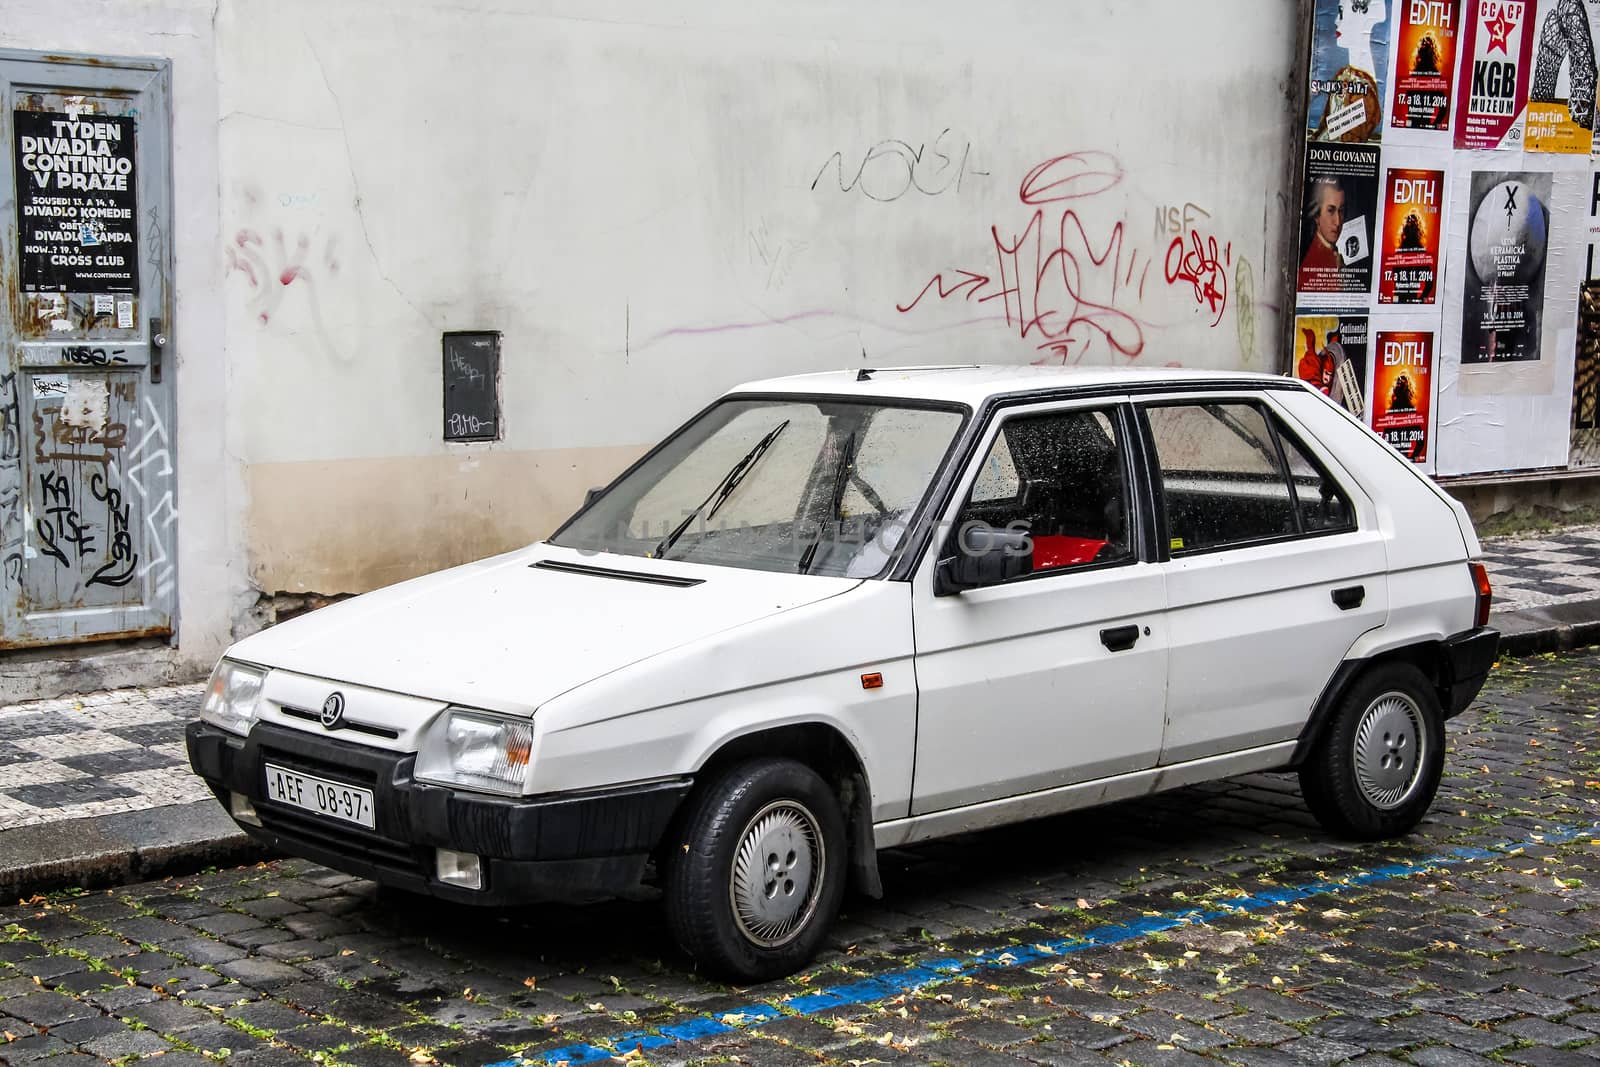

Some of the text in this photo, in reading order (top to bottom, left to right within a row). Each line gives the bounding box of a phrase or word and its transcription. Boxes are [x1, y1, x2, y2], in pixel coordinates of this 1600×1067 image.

[1410, 0, 1451, 28] EDITH
[1472, 60, 1516, 98] KGB
[1407, 96, 1411, 105] a
[1432, 95, 1447, 108] 2014
[1470, 98, 1514, 115] MUZEUM
[1529, 109, 1563, 123] martin
[22, 136, 112, 157] DIVADLA
[22, 153, 132, 175] CONTINUO
[1310, 149, 1377, 164] DON GIOVANNI
[33, 171, 128, 192] V PRAZE
[1394, 179, 1435, 205] EDITH
[32, 196, 71, 206] SOUSEDI
[86, 198, 94, 207] A
[24, 206, 132, 219] DIVADLO KOMEDIE
[51, 255, 125, 266] CROSS CLUB
[1393, 272, 1398, 281] a
[1418, 270, 1433, 282] 2014
[1384, 341, 1424, 366] EDITH
[1409, 430, 1424, 441] 2014
[276, 772, 362, 820] AEF 08-97
